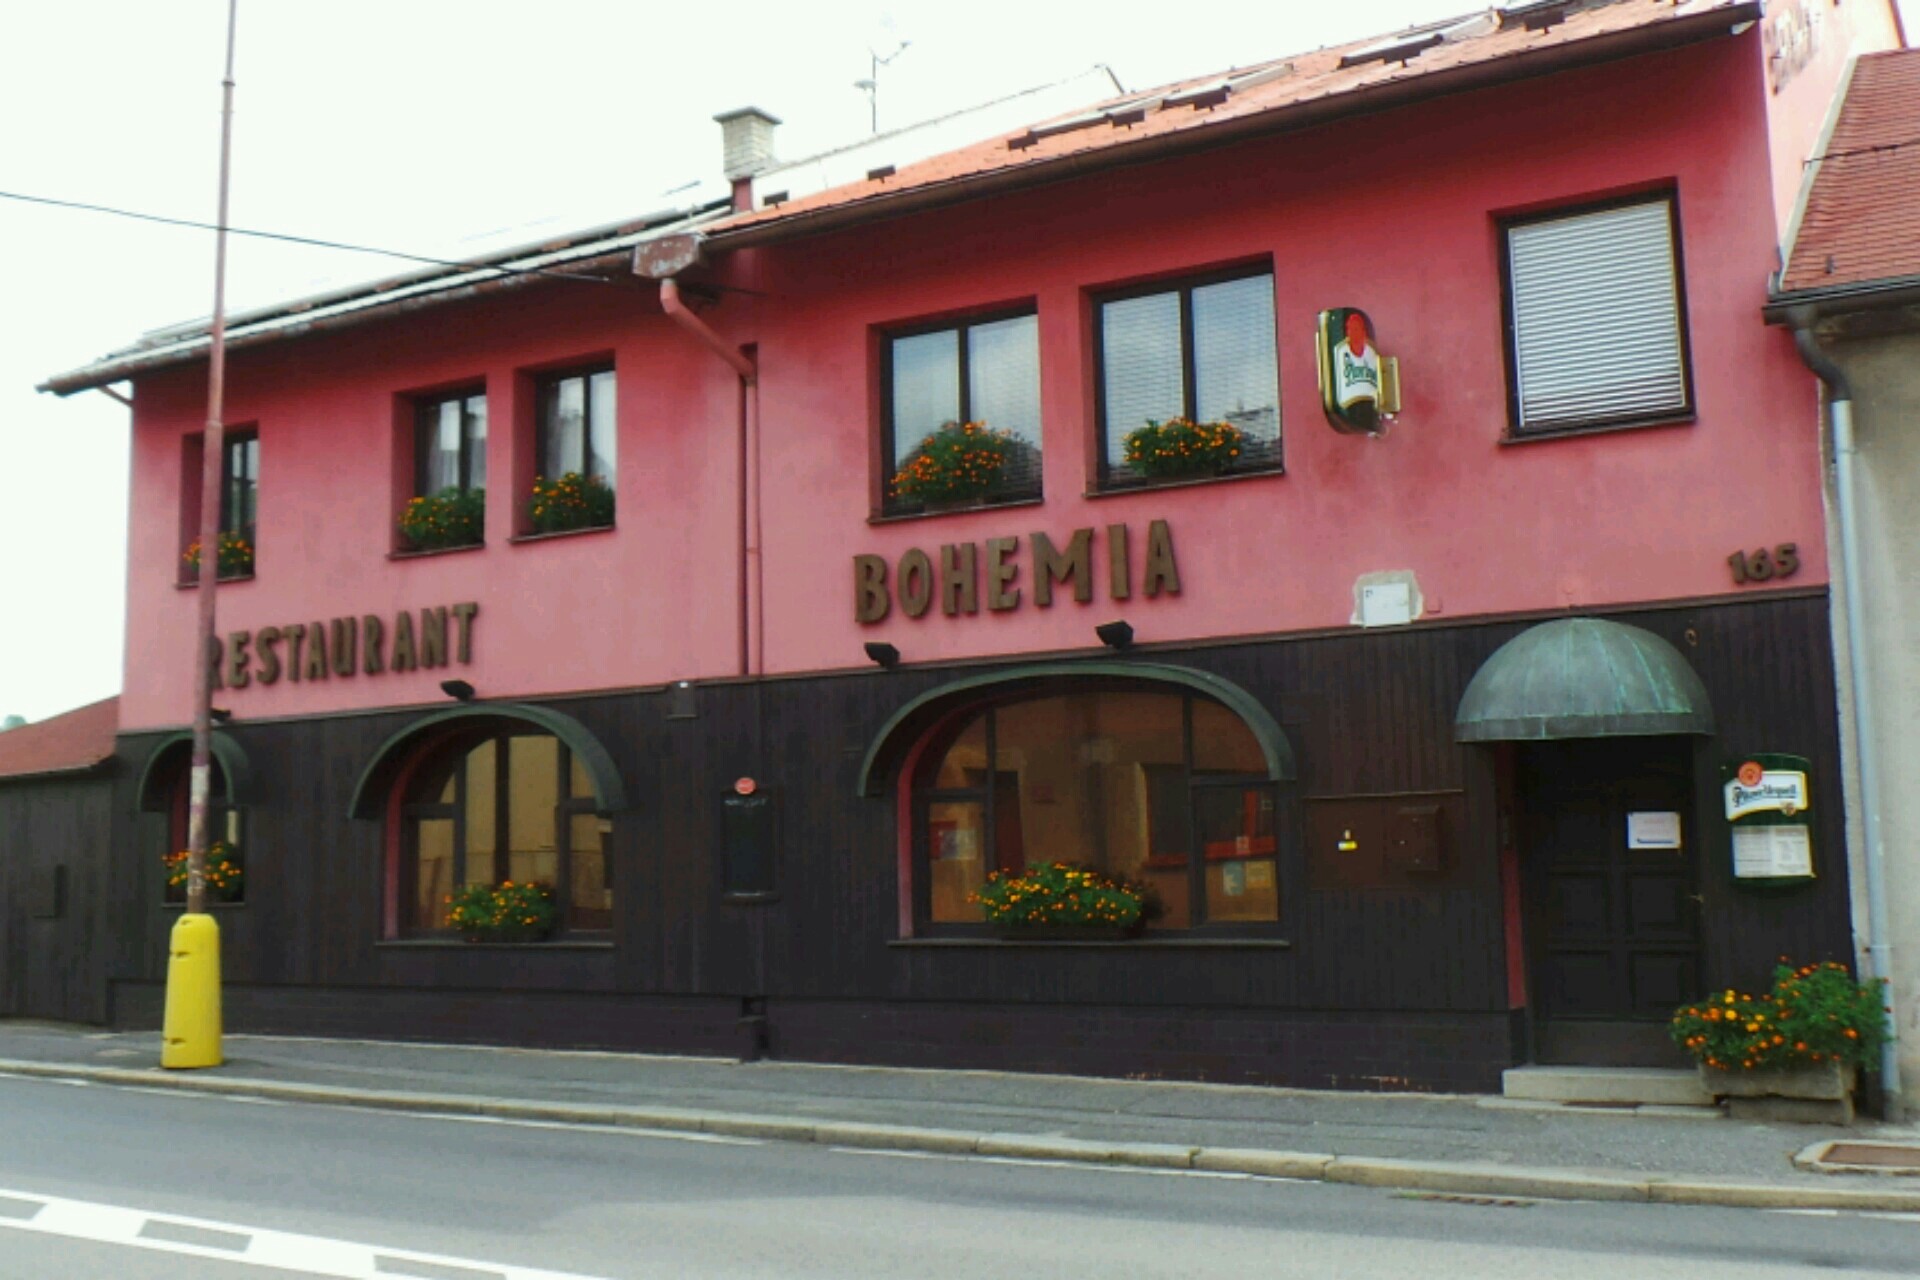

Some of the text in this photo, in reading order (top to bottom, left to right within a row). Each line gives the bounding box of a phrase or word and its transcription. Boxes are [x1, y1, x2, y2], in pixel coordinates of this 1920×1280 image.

[853, 519, 1181, 625] BOHEMIA
[1727, 542, 1799, 585] 165
[208, 601, 478, 690] RESTAURANT
